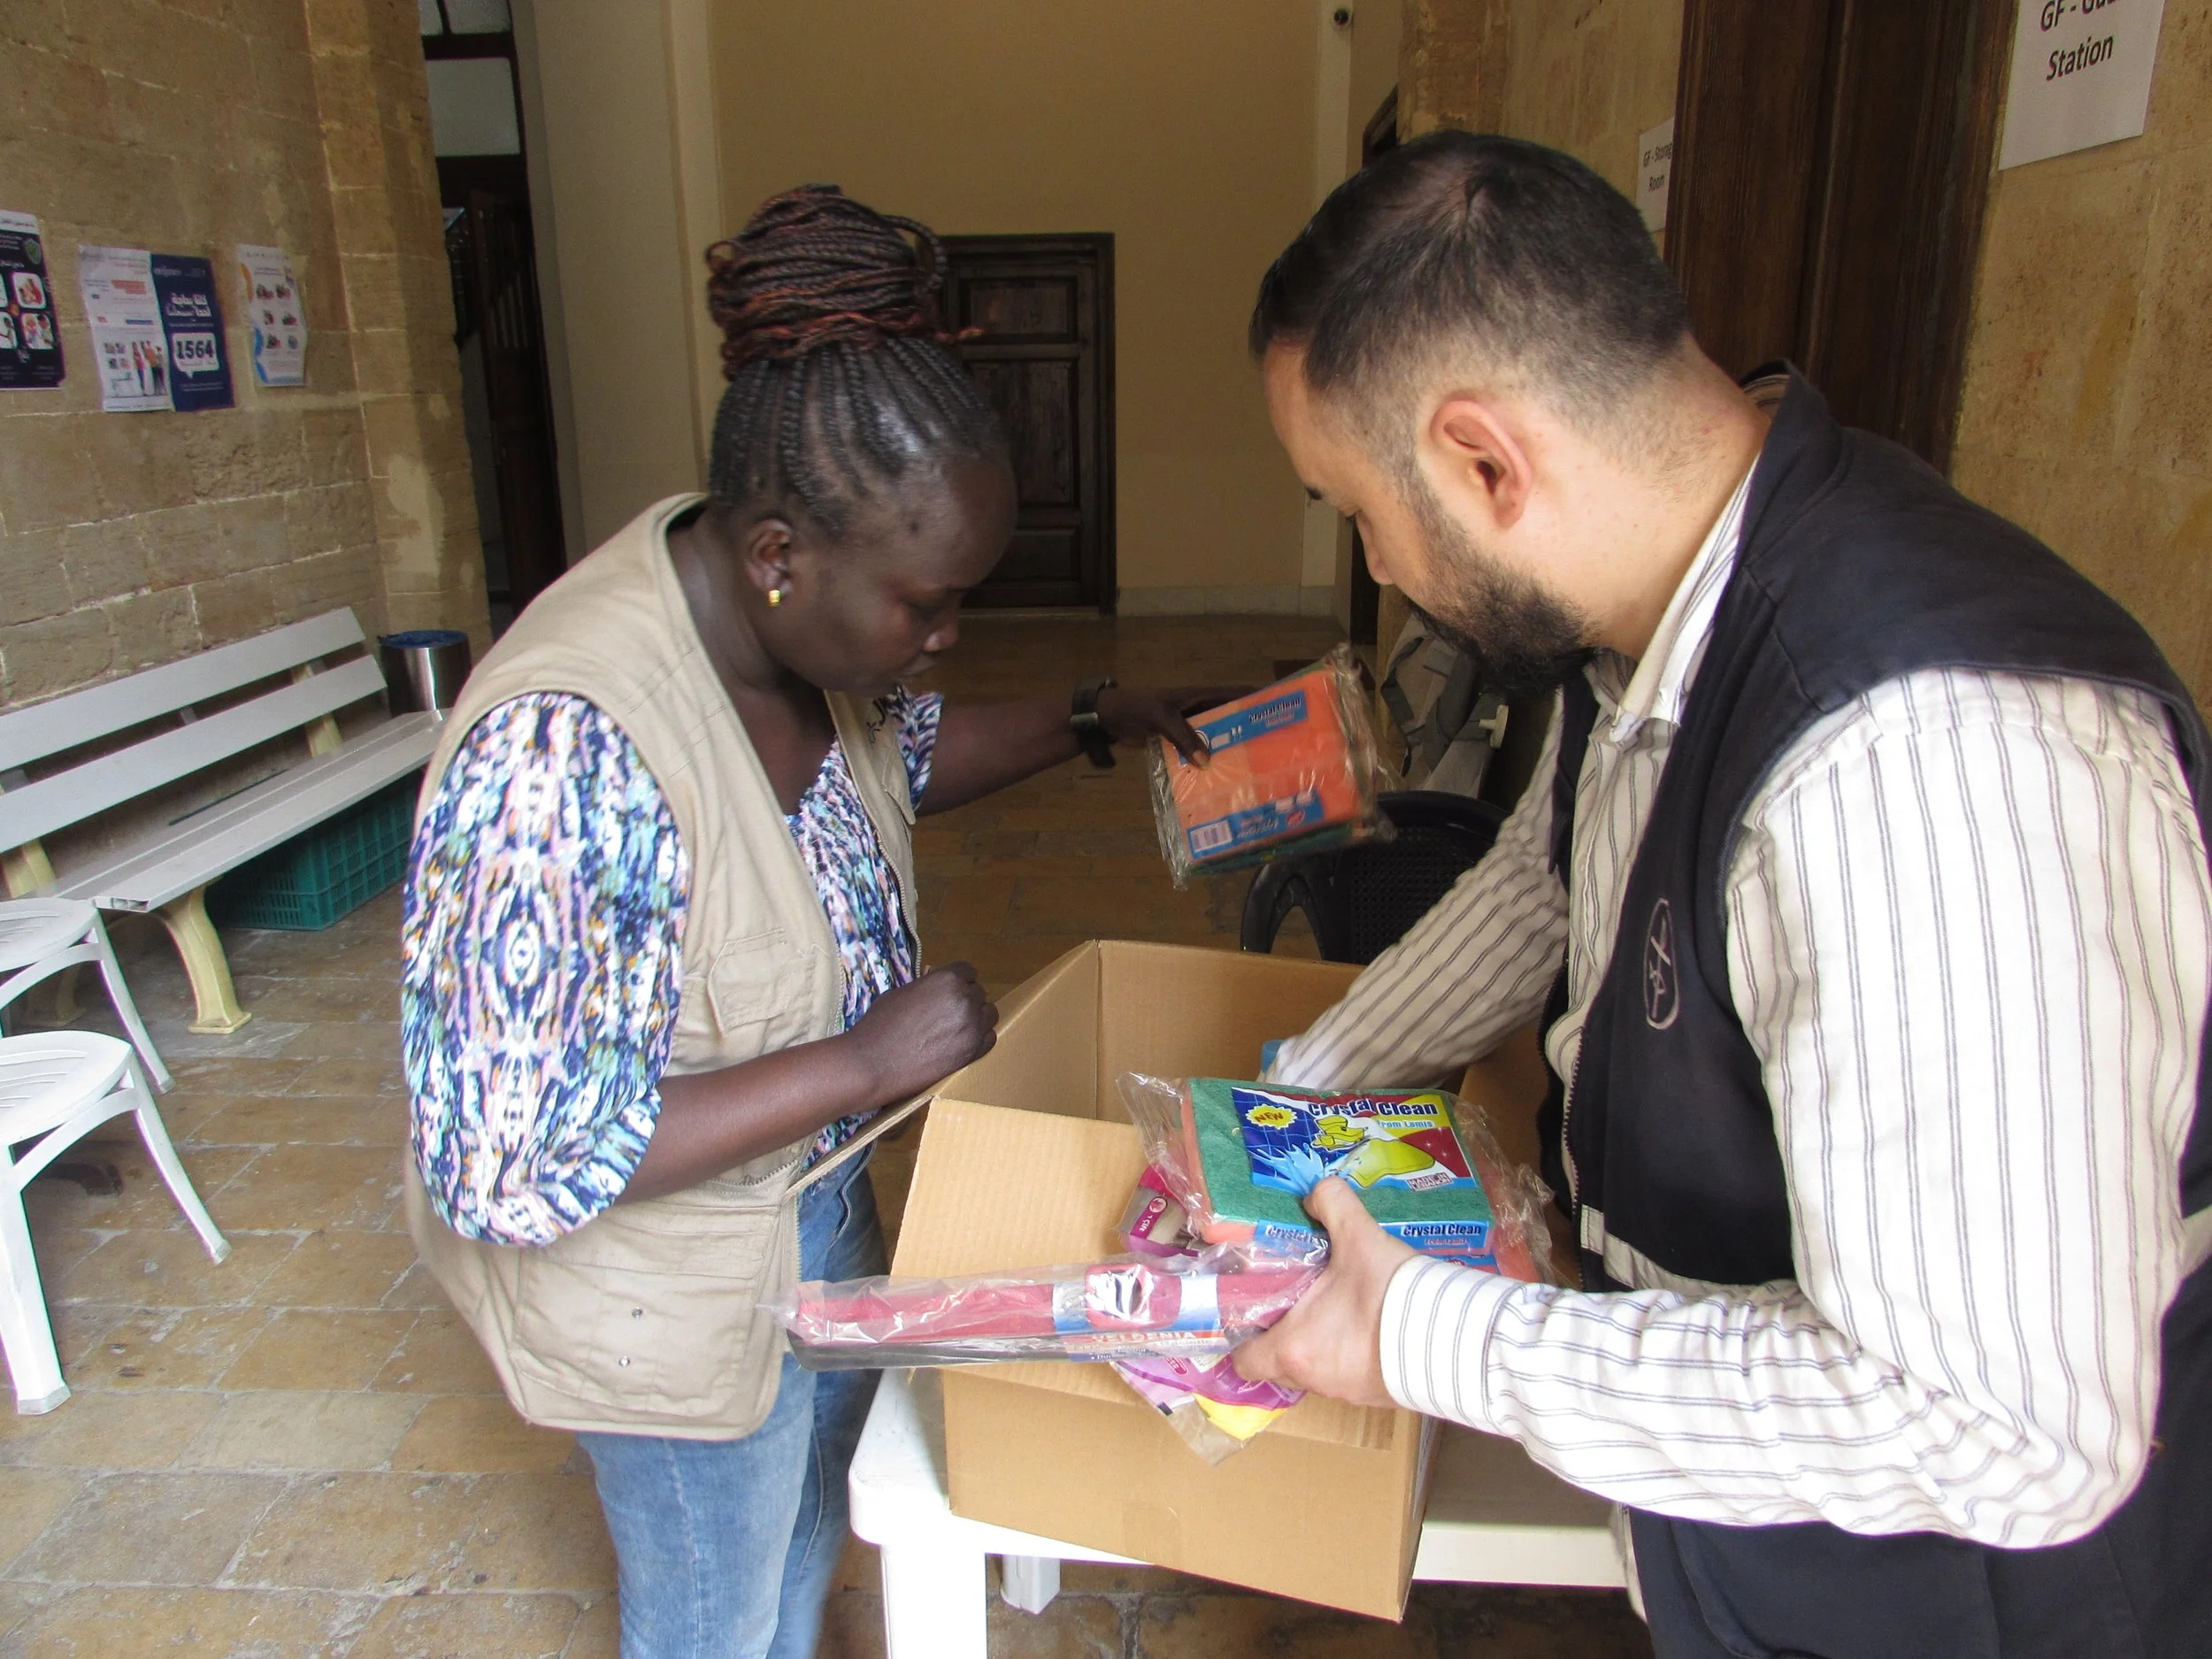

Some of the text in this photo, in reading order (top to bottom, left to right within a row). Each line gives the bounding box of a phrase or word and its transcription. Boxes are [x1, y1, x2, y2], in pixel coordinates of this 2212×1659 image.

[2040, 0, 2065, 32] GF
[2046, 36, 2114, 81] Station
[176, 341, 213, 359] 1564
[1310, 1098, 1438, 1116] Crystal Clean
[1254, 1112, 1284, 1123] NEW
[1402, 1224, 1482, 1236] Crystal Clean
